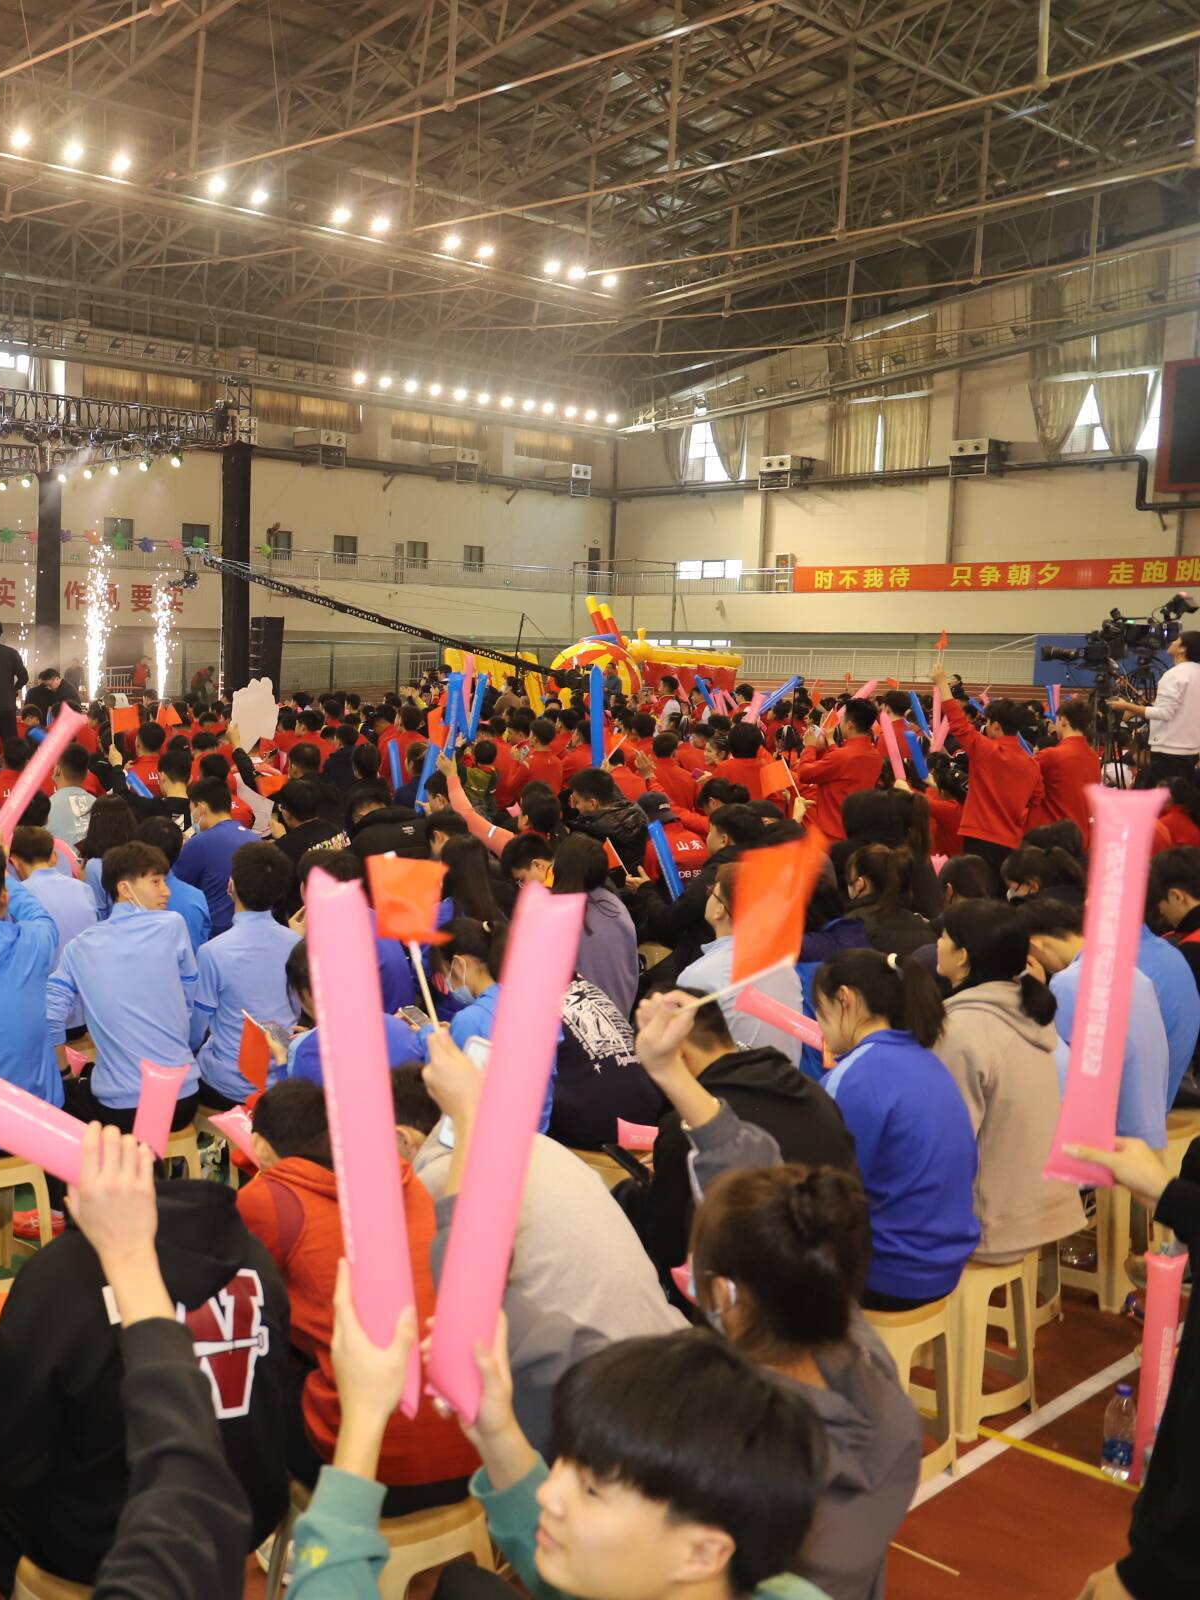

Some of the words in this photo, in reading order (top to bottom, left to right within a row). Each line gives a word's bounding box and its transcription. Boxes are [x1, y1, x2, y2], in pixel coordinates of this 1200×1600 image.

[814, 567, 911, 589] 时不我待
[950, 562, 1062, 587] 只争朝夕
[676, 839, 704, 852] 山东
